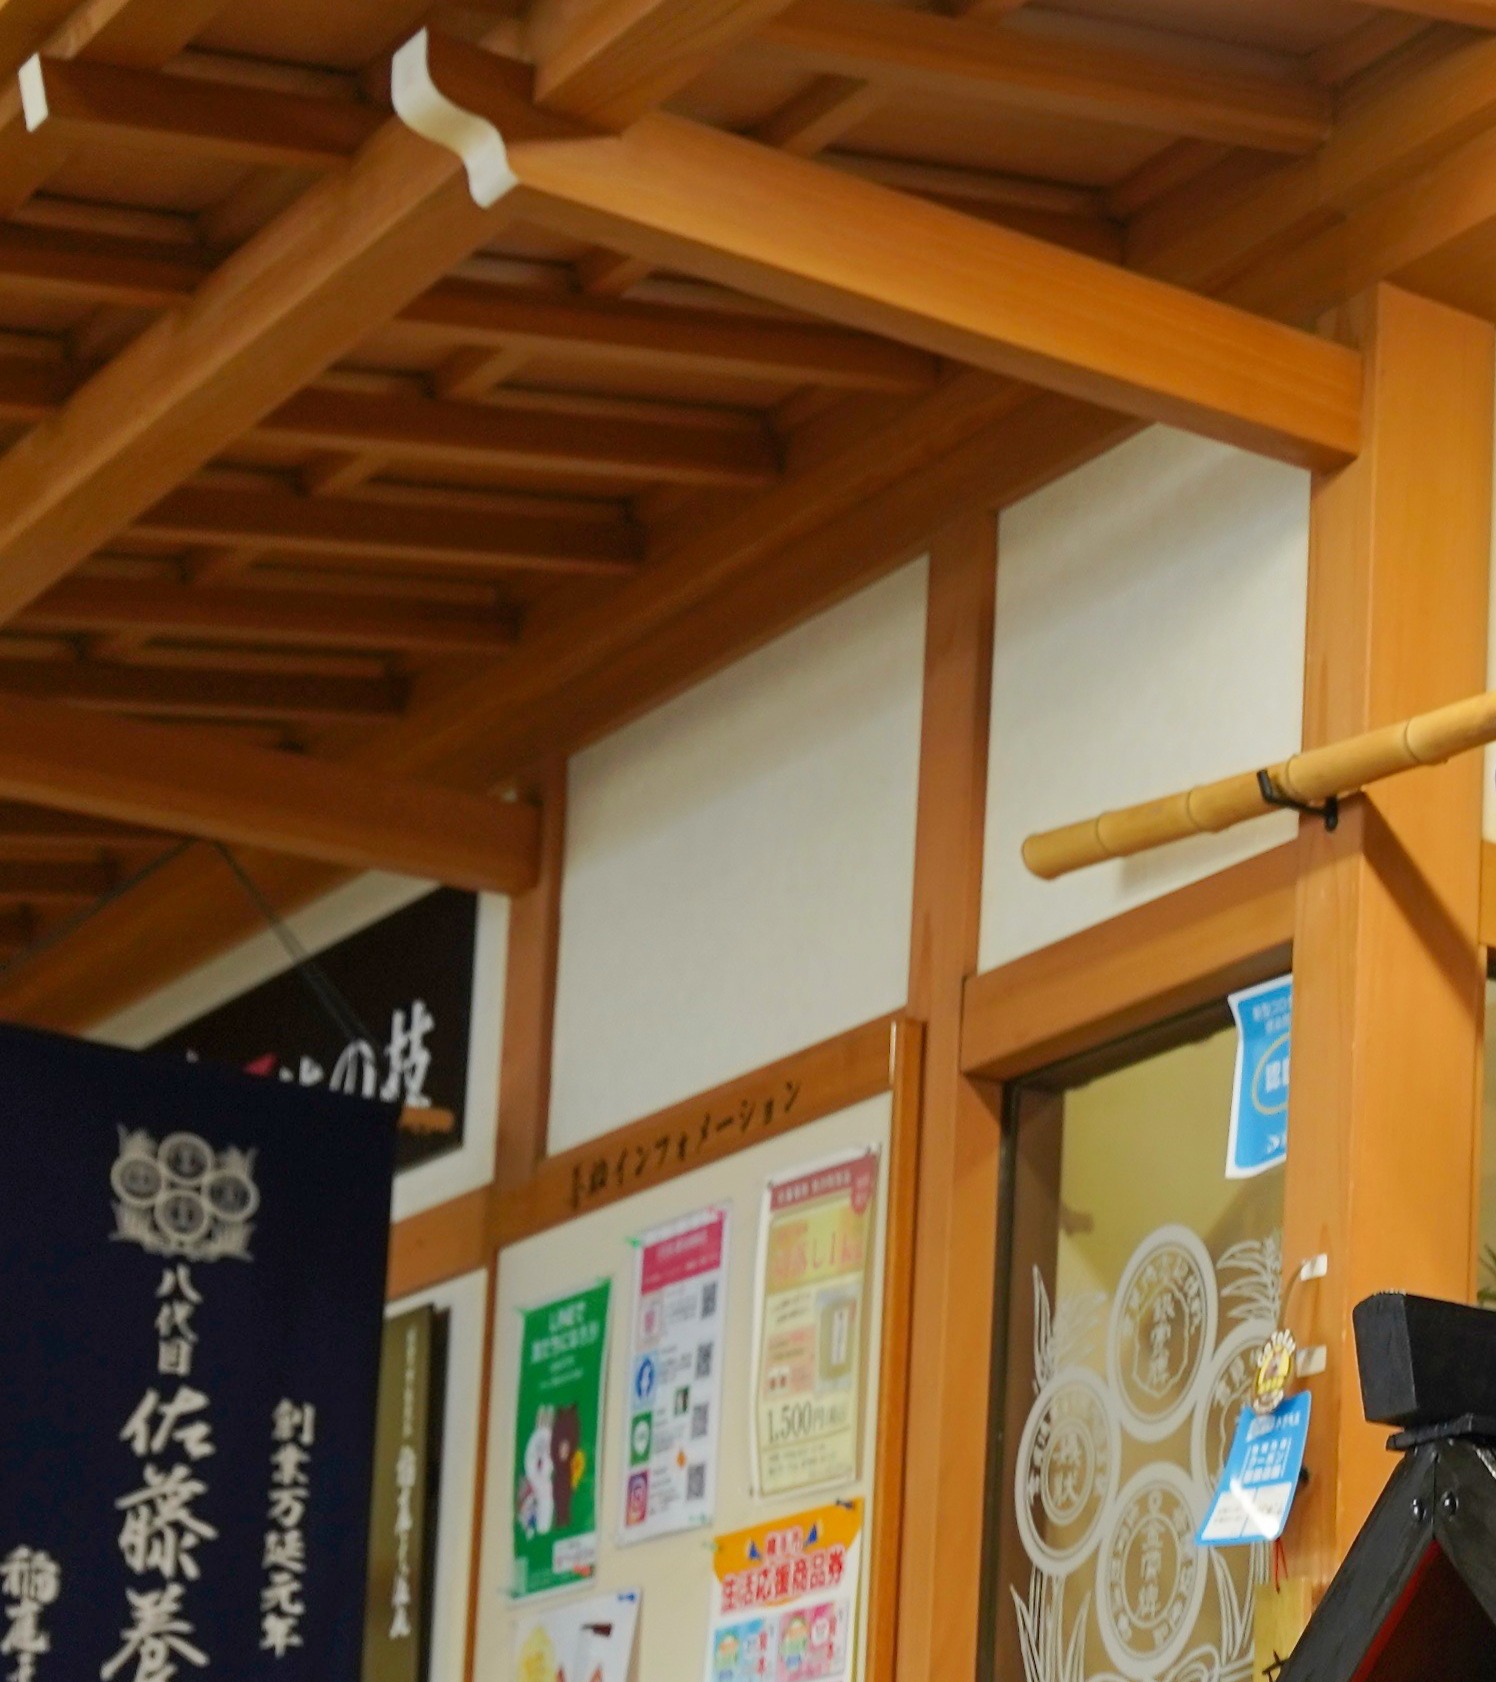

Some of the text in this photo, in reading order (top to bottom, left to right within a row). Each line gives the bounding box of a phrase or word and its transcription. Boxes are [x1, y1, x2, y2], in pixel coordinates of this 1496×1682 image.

[156, 1265, 202, 1376] 八代目
[259, 1398, 315, 1658] 創業万延元年
